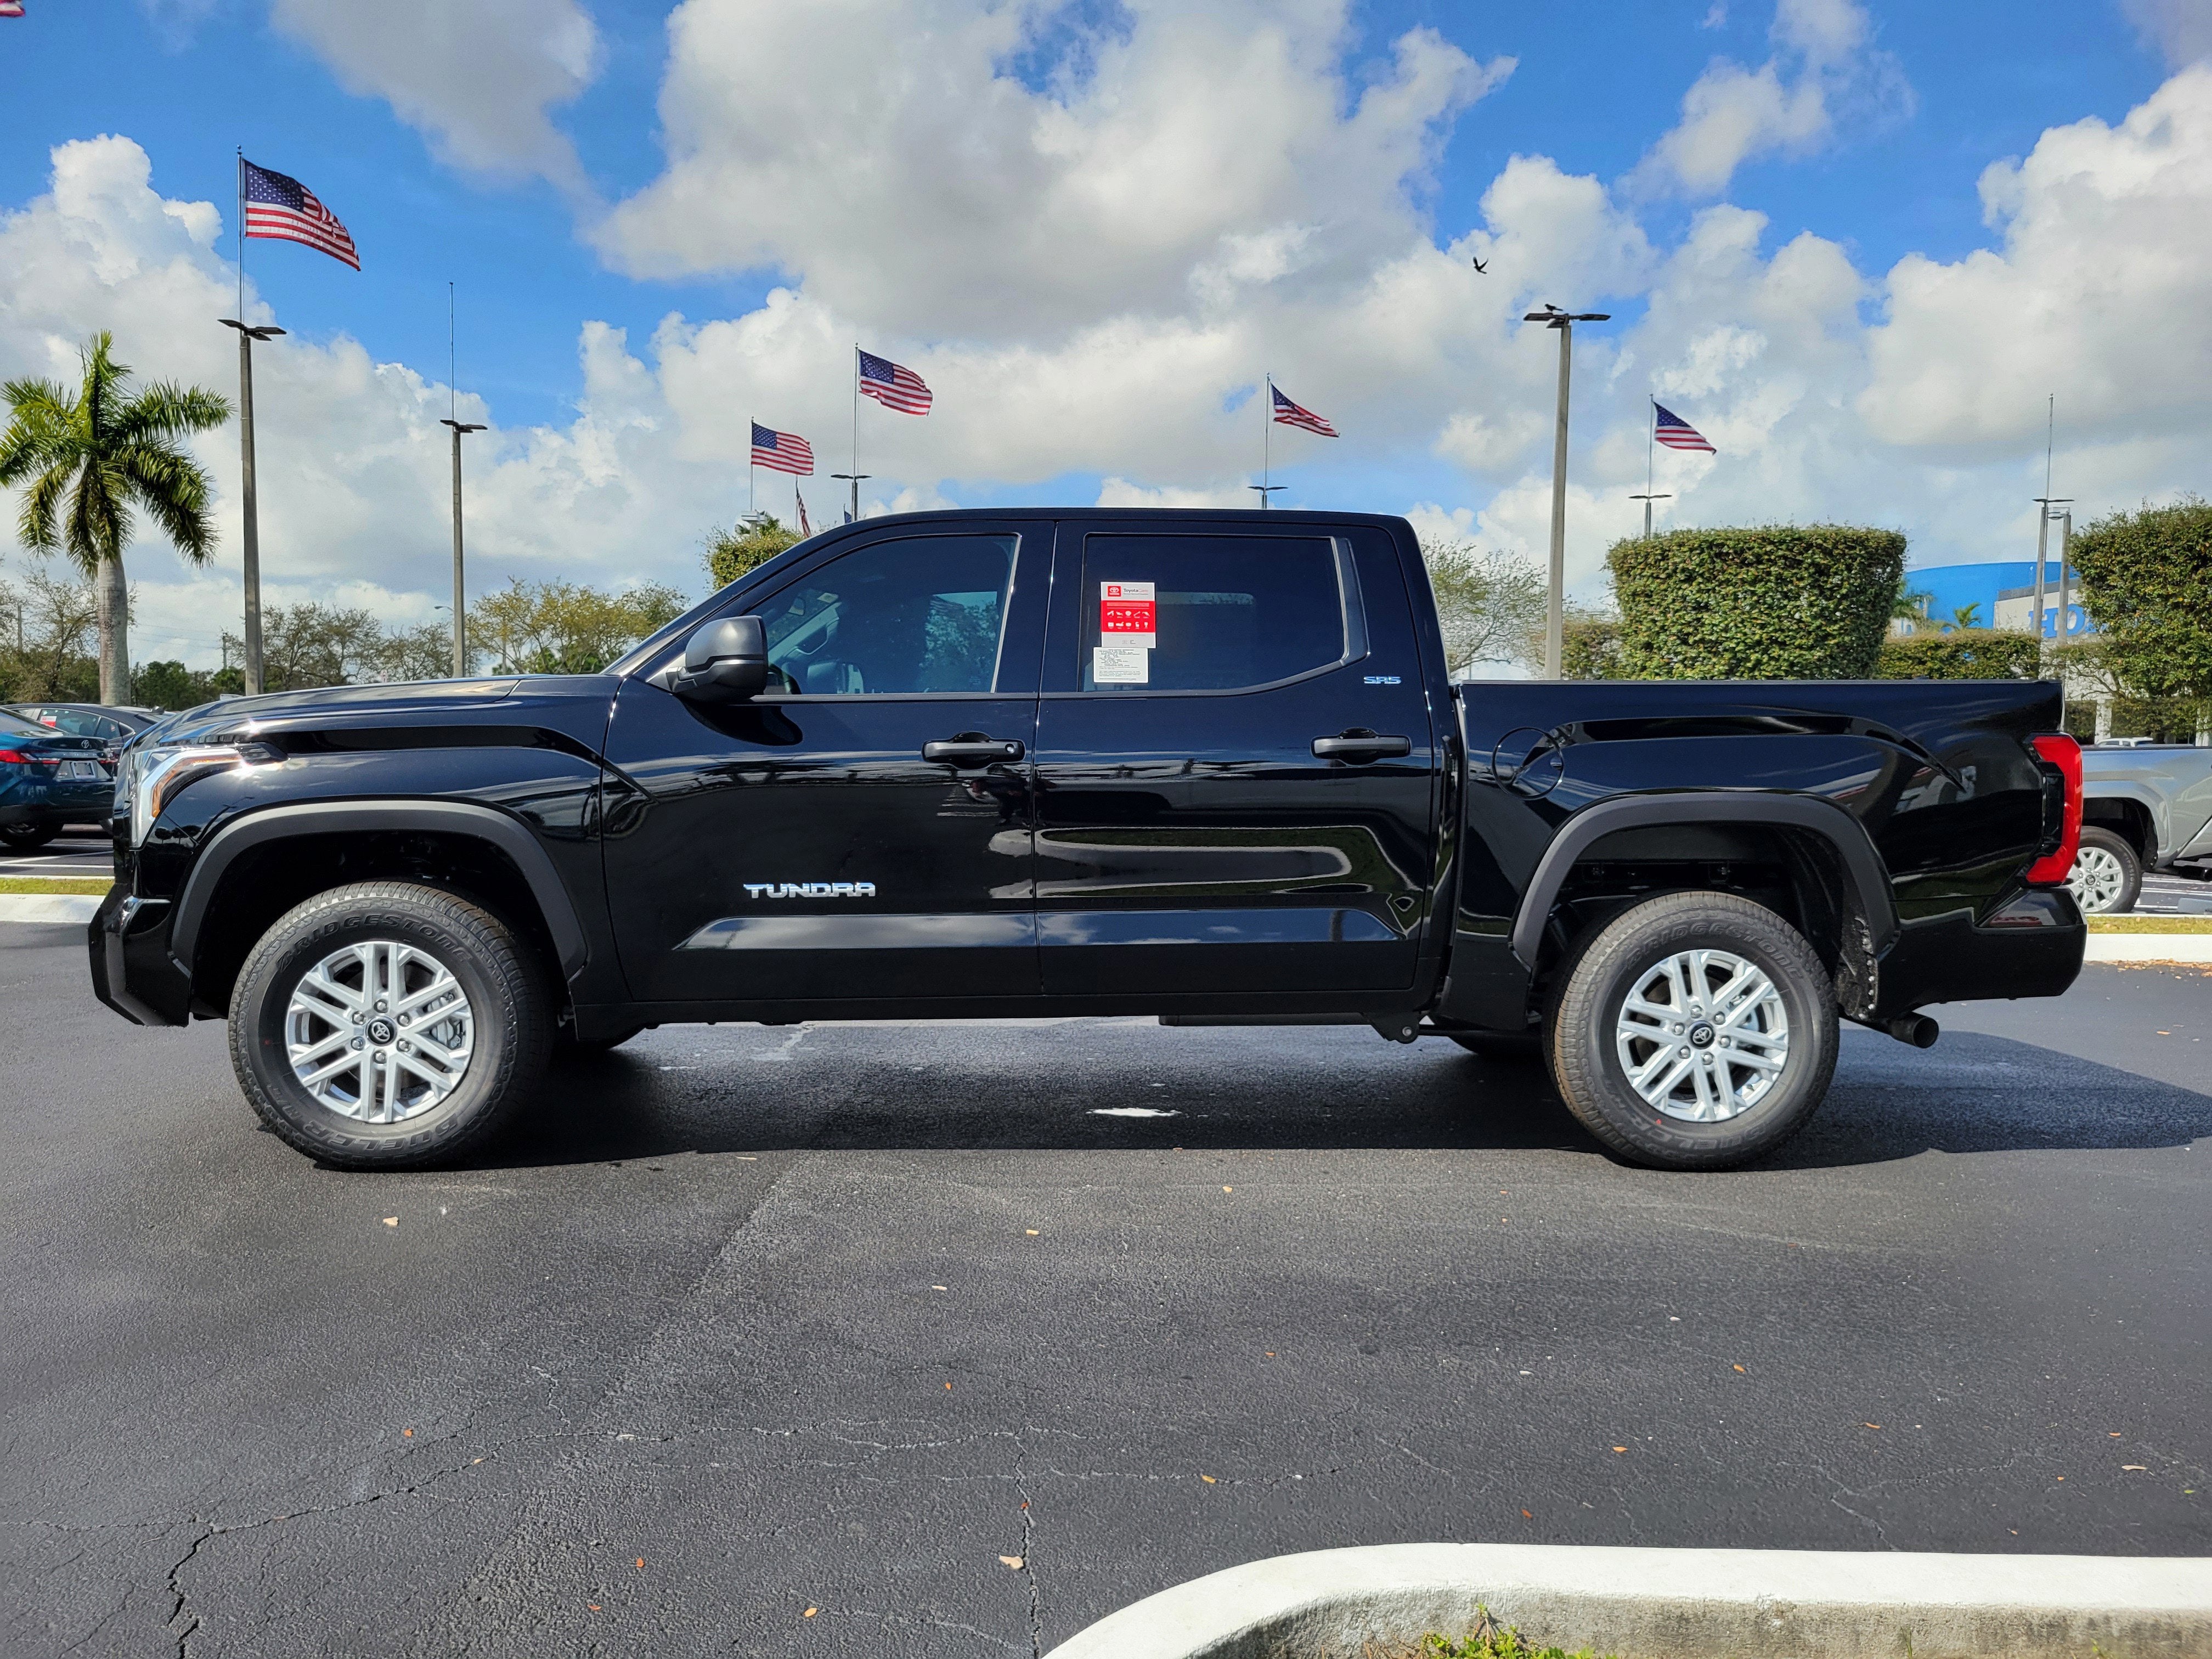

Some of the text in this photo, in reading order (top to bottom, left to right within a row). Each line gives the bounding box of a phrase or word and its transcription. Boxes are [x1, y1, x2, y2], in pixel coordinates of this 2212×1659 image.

[1363, 676, 1402, 684] SR5
[743, 882, 876, 899] TUNDRA
[276, 913, 473, 972] BRIDGESTONE
[1626, 923, 1804, 979] BRIDGESTONE
